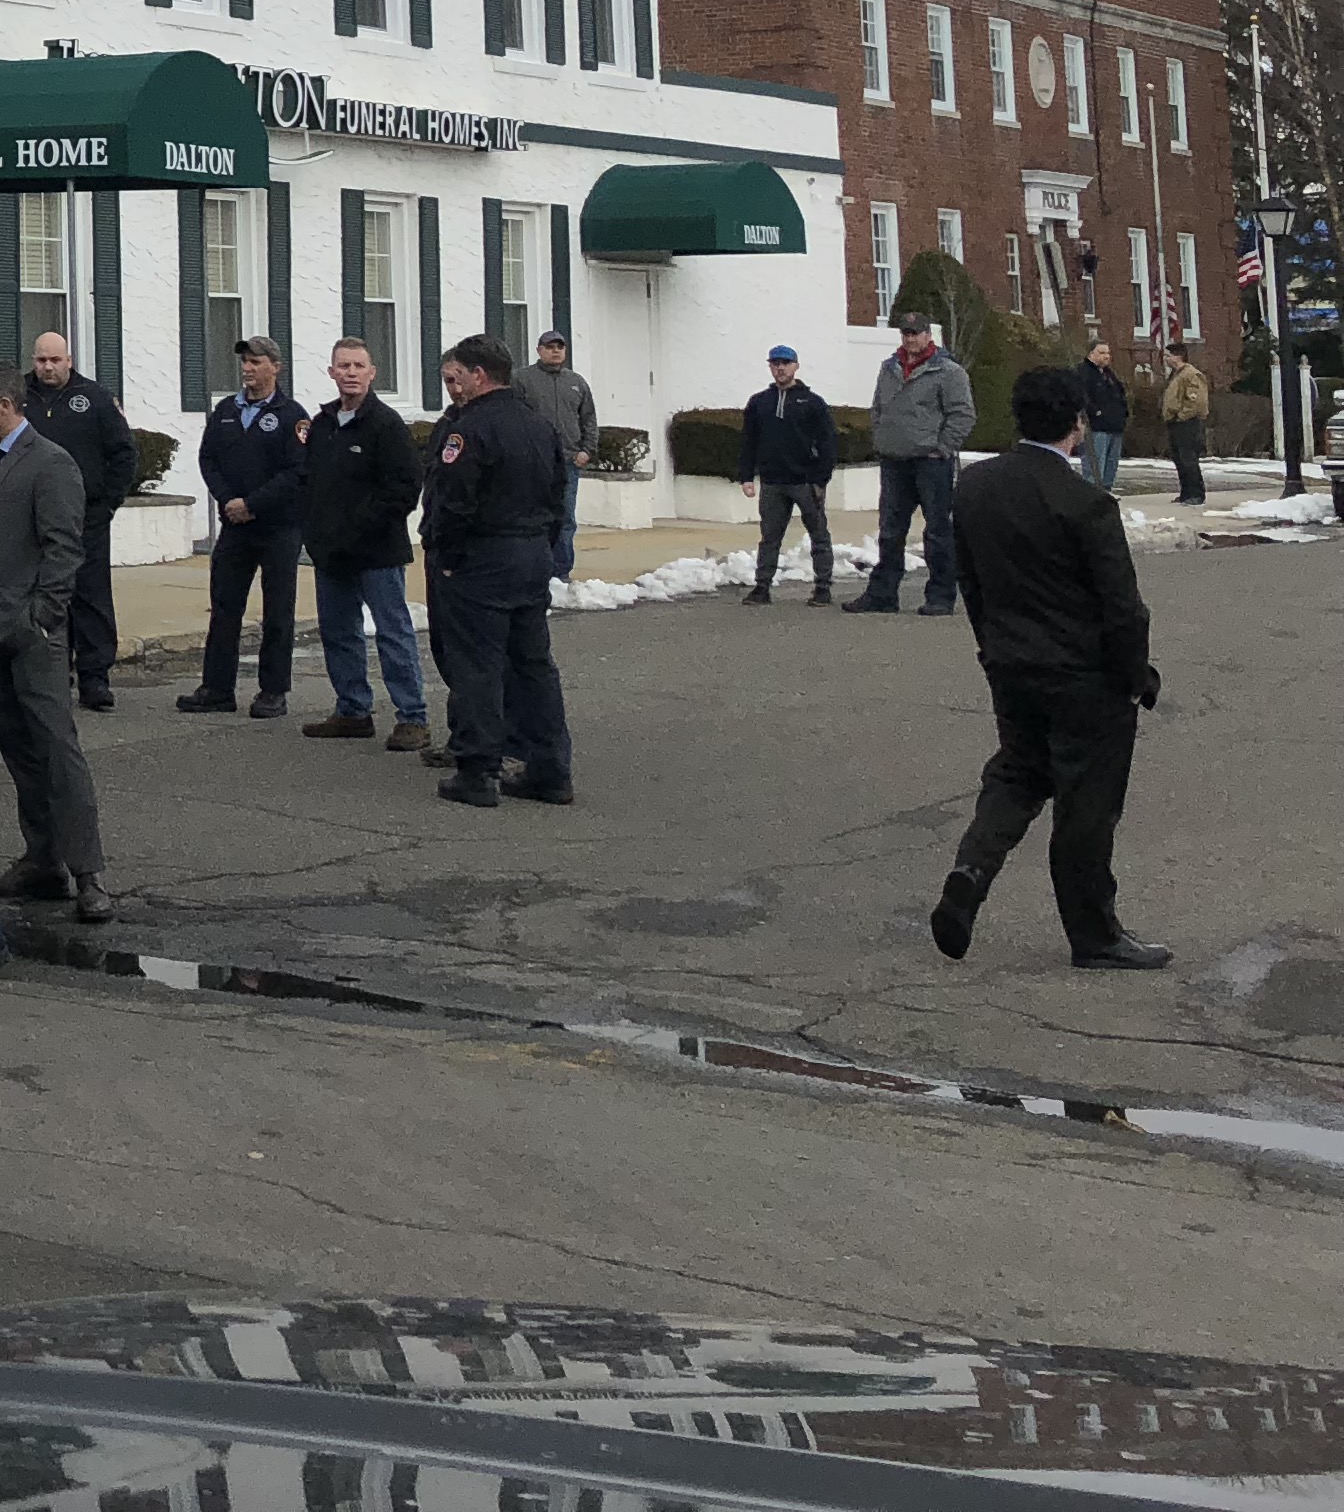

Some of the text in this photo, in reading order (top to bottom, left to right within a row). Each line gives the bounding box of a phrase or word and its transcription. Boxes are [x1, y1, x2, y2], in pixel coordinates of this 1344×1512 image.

[336, 98, 420, 140] FUNERAL
[427, 109, 492, 152] HOMES,
[496, 117, 528, 152] INC.
[15, 138, 108, 168] HOME
[164, 141, 235, 176] DALTON
[743, 224, 780, 245] DALTON
